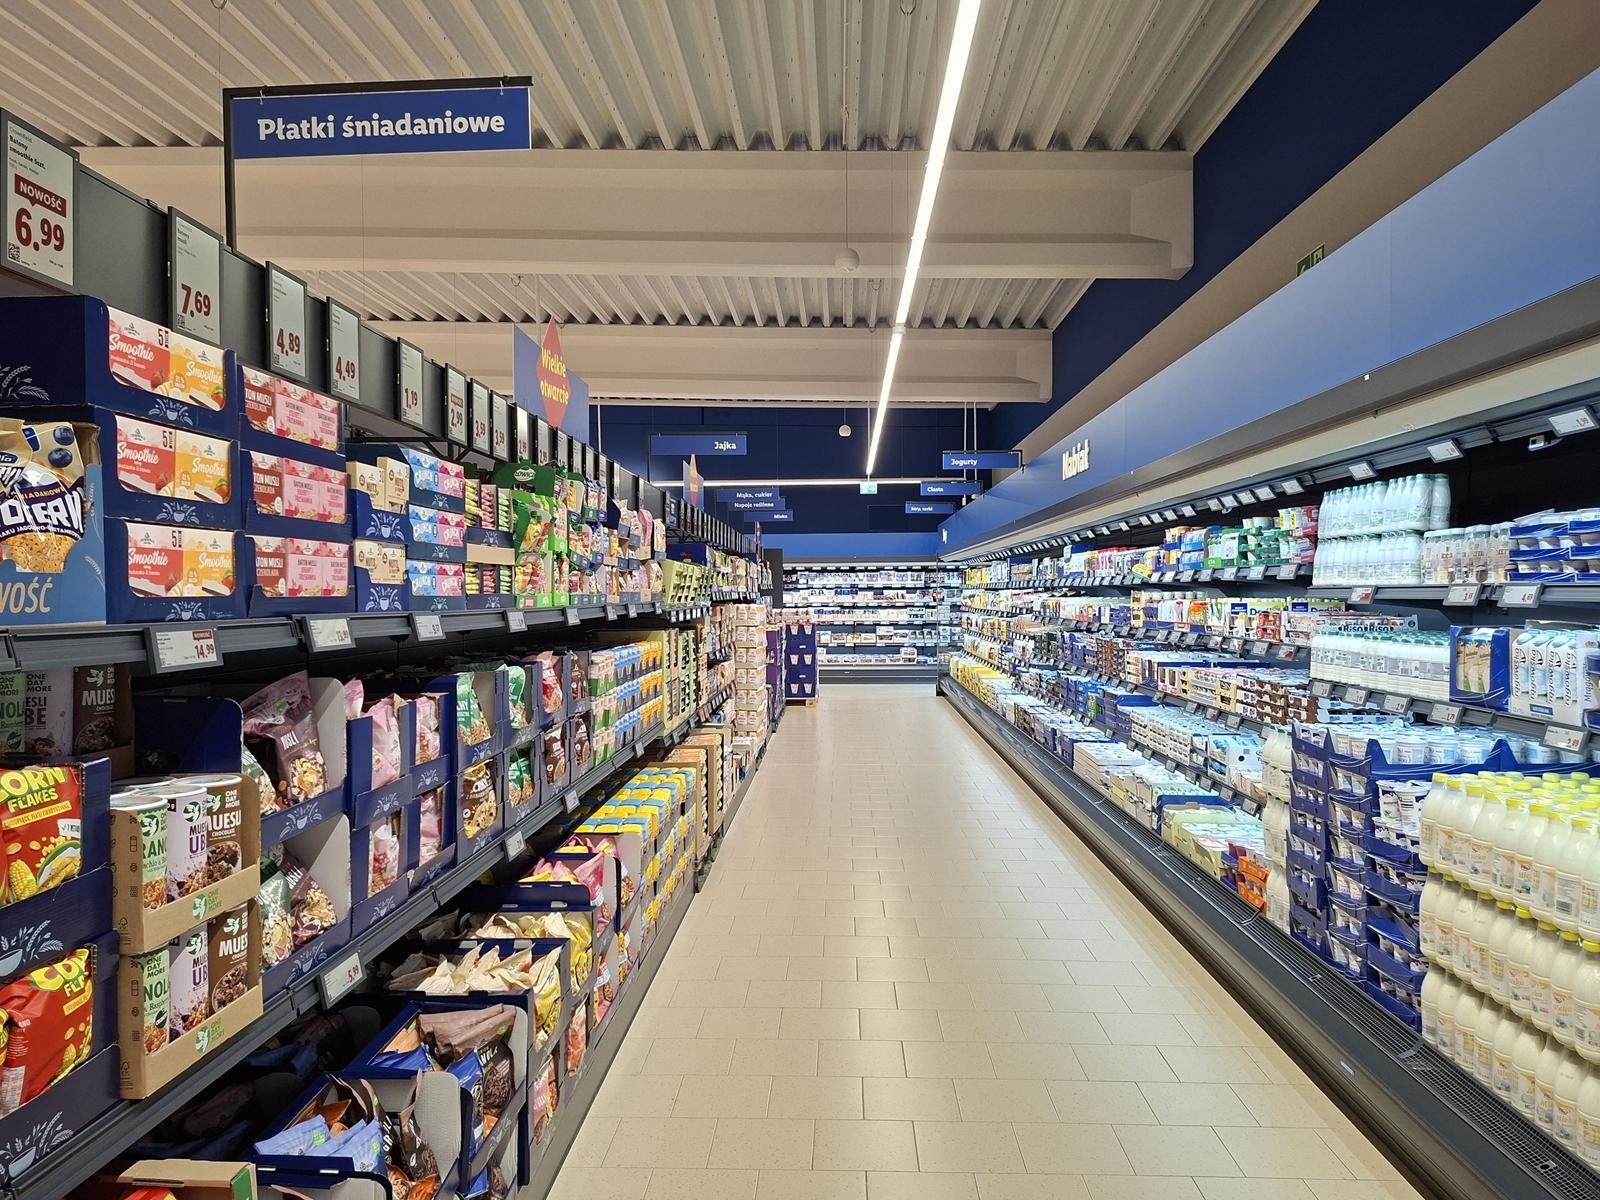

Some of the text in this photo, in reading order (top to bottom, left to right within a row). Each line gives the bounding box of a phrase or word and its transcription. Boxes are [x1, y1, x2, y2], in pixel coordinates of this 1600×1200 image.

[257, 110, 505, 141] Płatki śniadaniowe
[20, 181, 62, 211] NOWOŚĆ
[15, 208, 65, 251] 6.99
[181, 283, 211, 318] 7.69
[109, 333, 155, 362] Smoothie
[276, 328, 301, 356] 4.89
[186, 361, 223, 384] Smoothie
[336, 356, 356, 382] 4.49
[541, 347, 567, 378] Wielkie
[404, 388, 418, 410] 1.19
[540, 379, 569, 405] otwarcie
[450, 408, 463, 428] 2.99
[475, 420, 486, 439] 3.59
[117, 442, 159, 465] Smoothie
[714, 441, 737, 451] Jajka
[192, 458, 226, 476] Smoothie
[951, 458, 978, 467] Jogurty
[128, 547, 168, 566] Smoothie
[199, 552, 231, 569] Smoothie
[194, 643, 214, 659] 14.99
[82, 688, 115, 706] MUES
[7, 787, 59, 813] FLAKES
[212, 829, 235, 837] CHOCOLATE
[219, 932, 248, 957] MUES
[147, 955, 162, 965] ONE
[147, 962, 161, 972] DAY
[147, 967, 165, 979] MORE
[348, 964, 359, 982] 5.99
